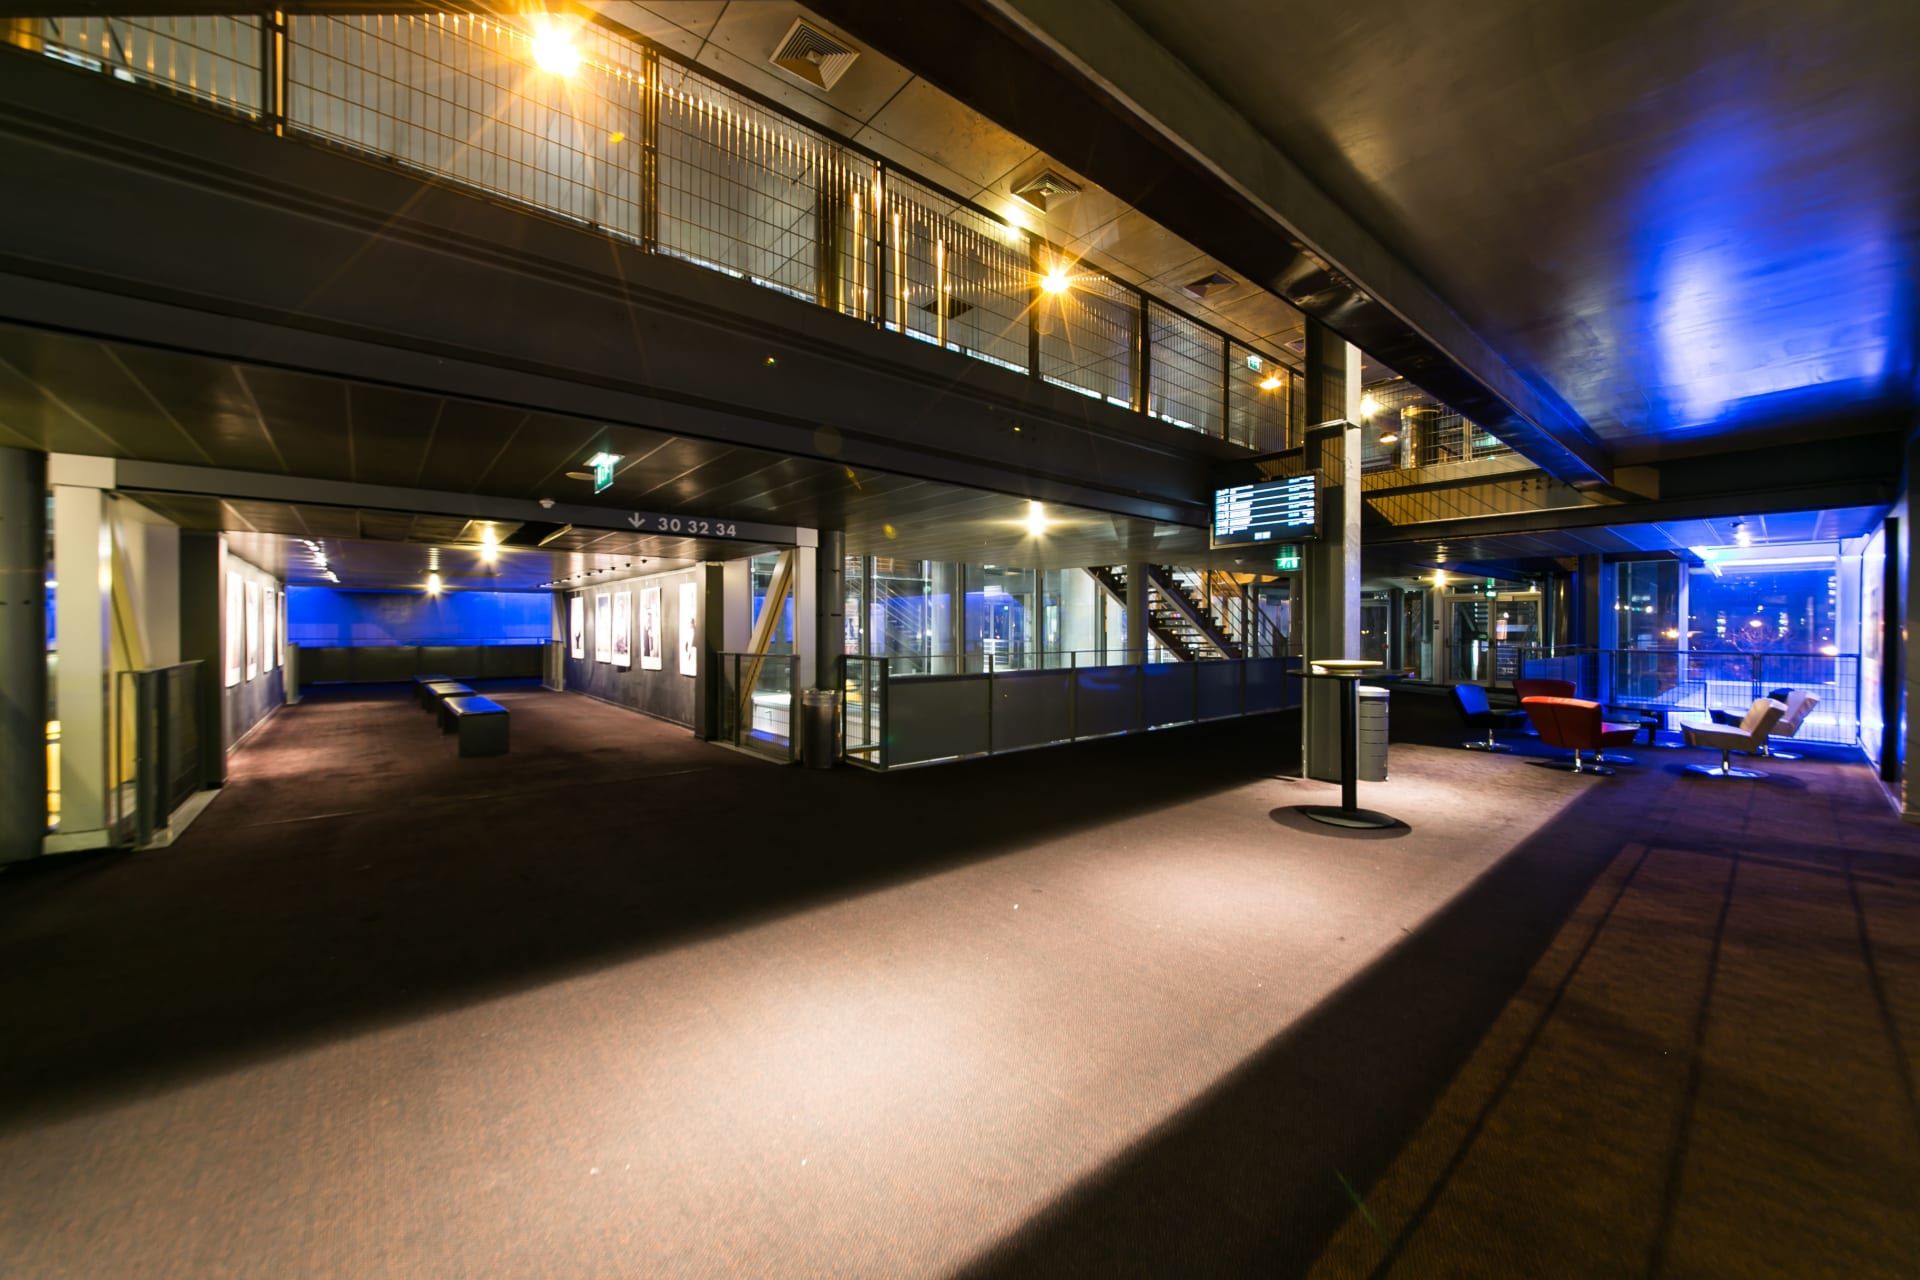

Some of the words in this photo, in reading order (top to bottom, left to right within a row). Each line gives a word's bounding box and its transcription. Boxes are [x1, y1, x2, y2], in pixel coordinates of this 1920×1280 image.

[658, 517, 681, 532] 30
[687, 520, 709, 535] 32
[715, 523, 737, 537] 34
